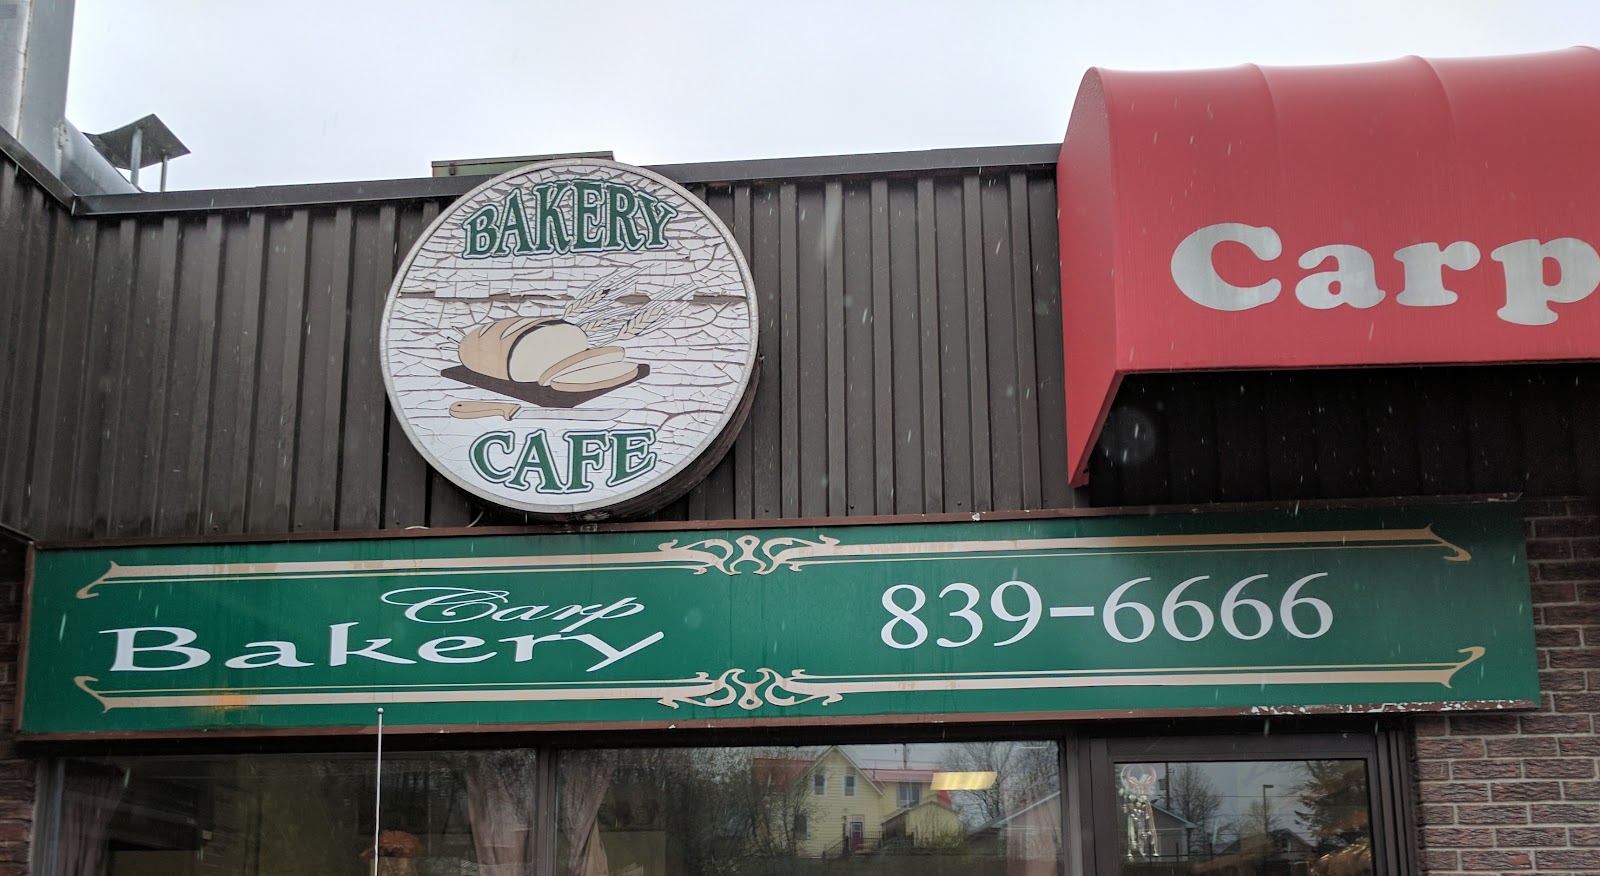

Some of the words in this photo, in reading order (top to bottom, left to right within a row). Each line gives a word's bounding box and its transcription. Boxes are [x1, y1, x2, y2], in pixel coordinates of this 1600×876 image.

[461, 178, 678, 260] BAKERY
[1170, 222, 1600, 326] Carp
[469, 428, 658, 494] CAFE
[381, 586, 645, 633] Carp
[880, 572, 1334, 649] 839-6666
[98, 621, 665, 672] Bakery
